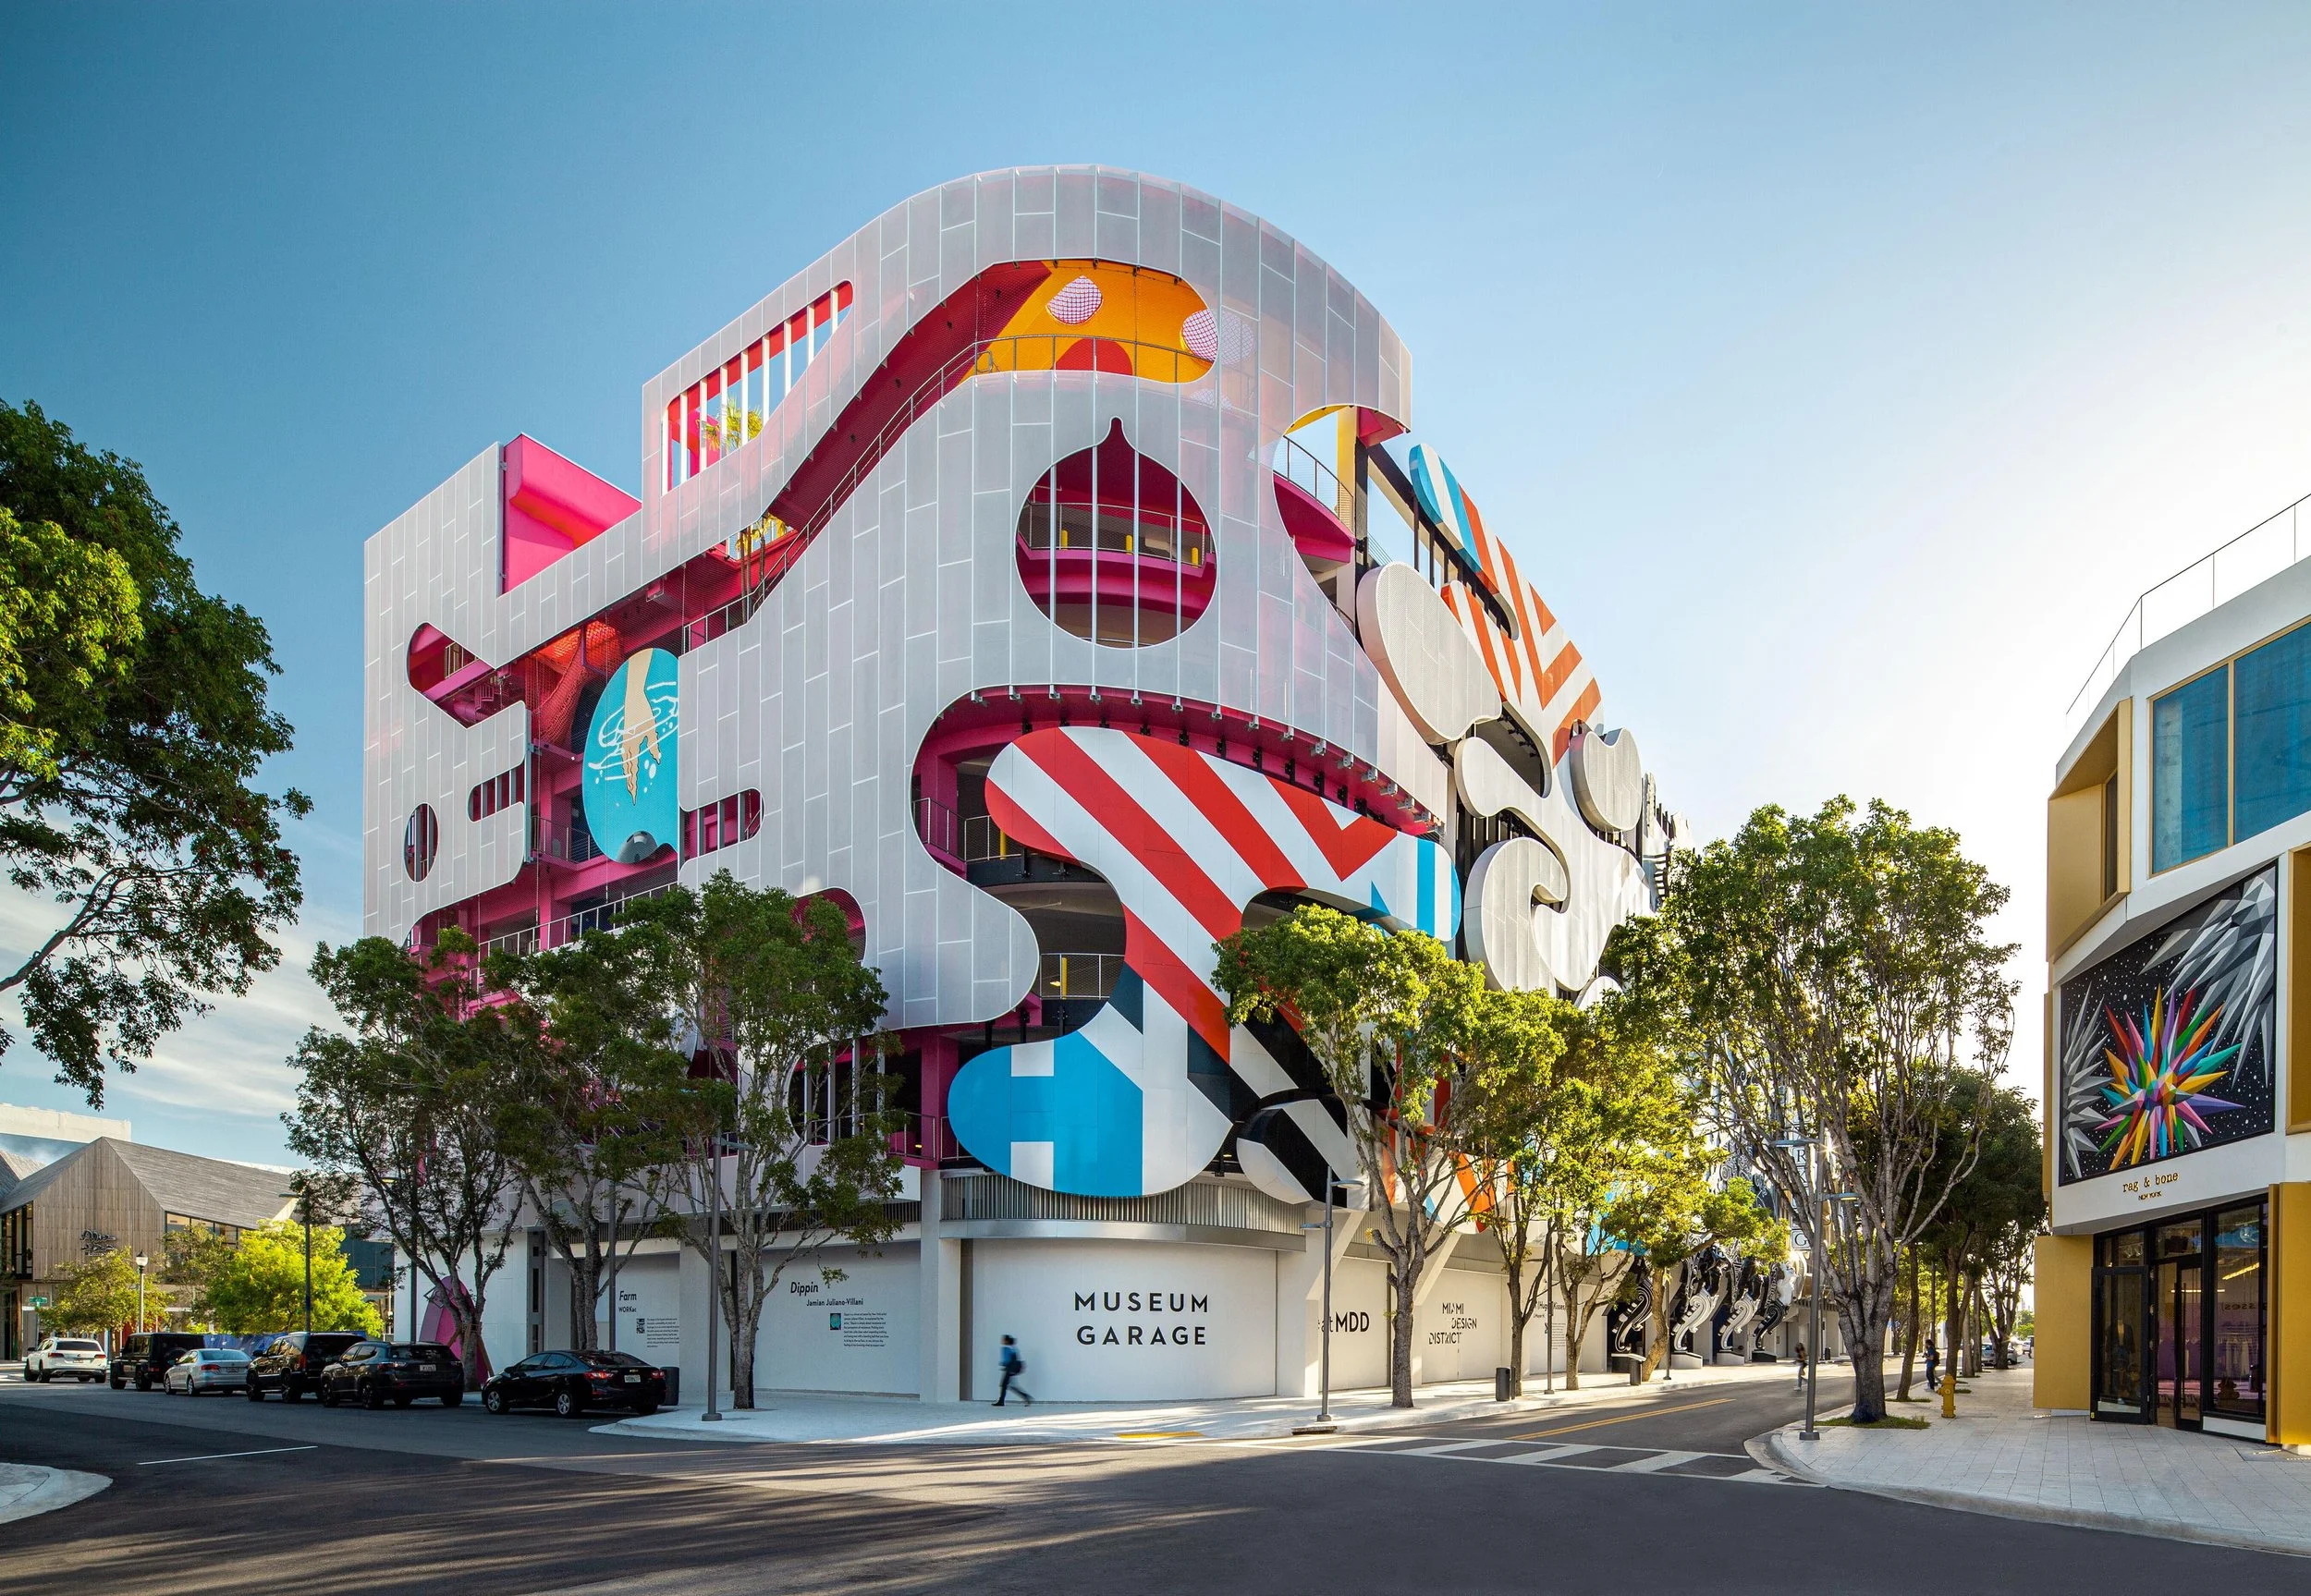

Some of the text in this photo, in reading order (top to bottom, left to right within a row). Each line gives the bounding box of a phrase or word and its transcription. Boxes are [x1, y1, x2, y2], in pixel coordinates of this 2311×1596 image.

[2122, 1172, 2179, 1192] rag & bone
[618, 1290, 637, 1301] Farm
[790, 1282, 819, 1297] Dippin
[825, 1298, 864, 1306] Juliano-Villani
[1074, 1291, 1208, 1313] MUSEUM
[1442, 1302, 1464, 1315] MIAMI
[1450, 1317, 1477, 1329] DESIGN
[1076, 1324, 1206, 1346] GARAGE
[1428, 1332, 1462, 1345] DISTRICT
